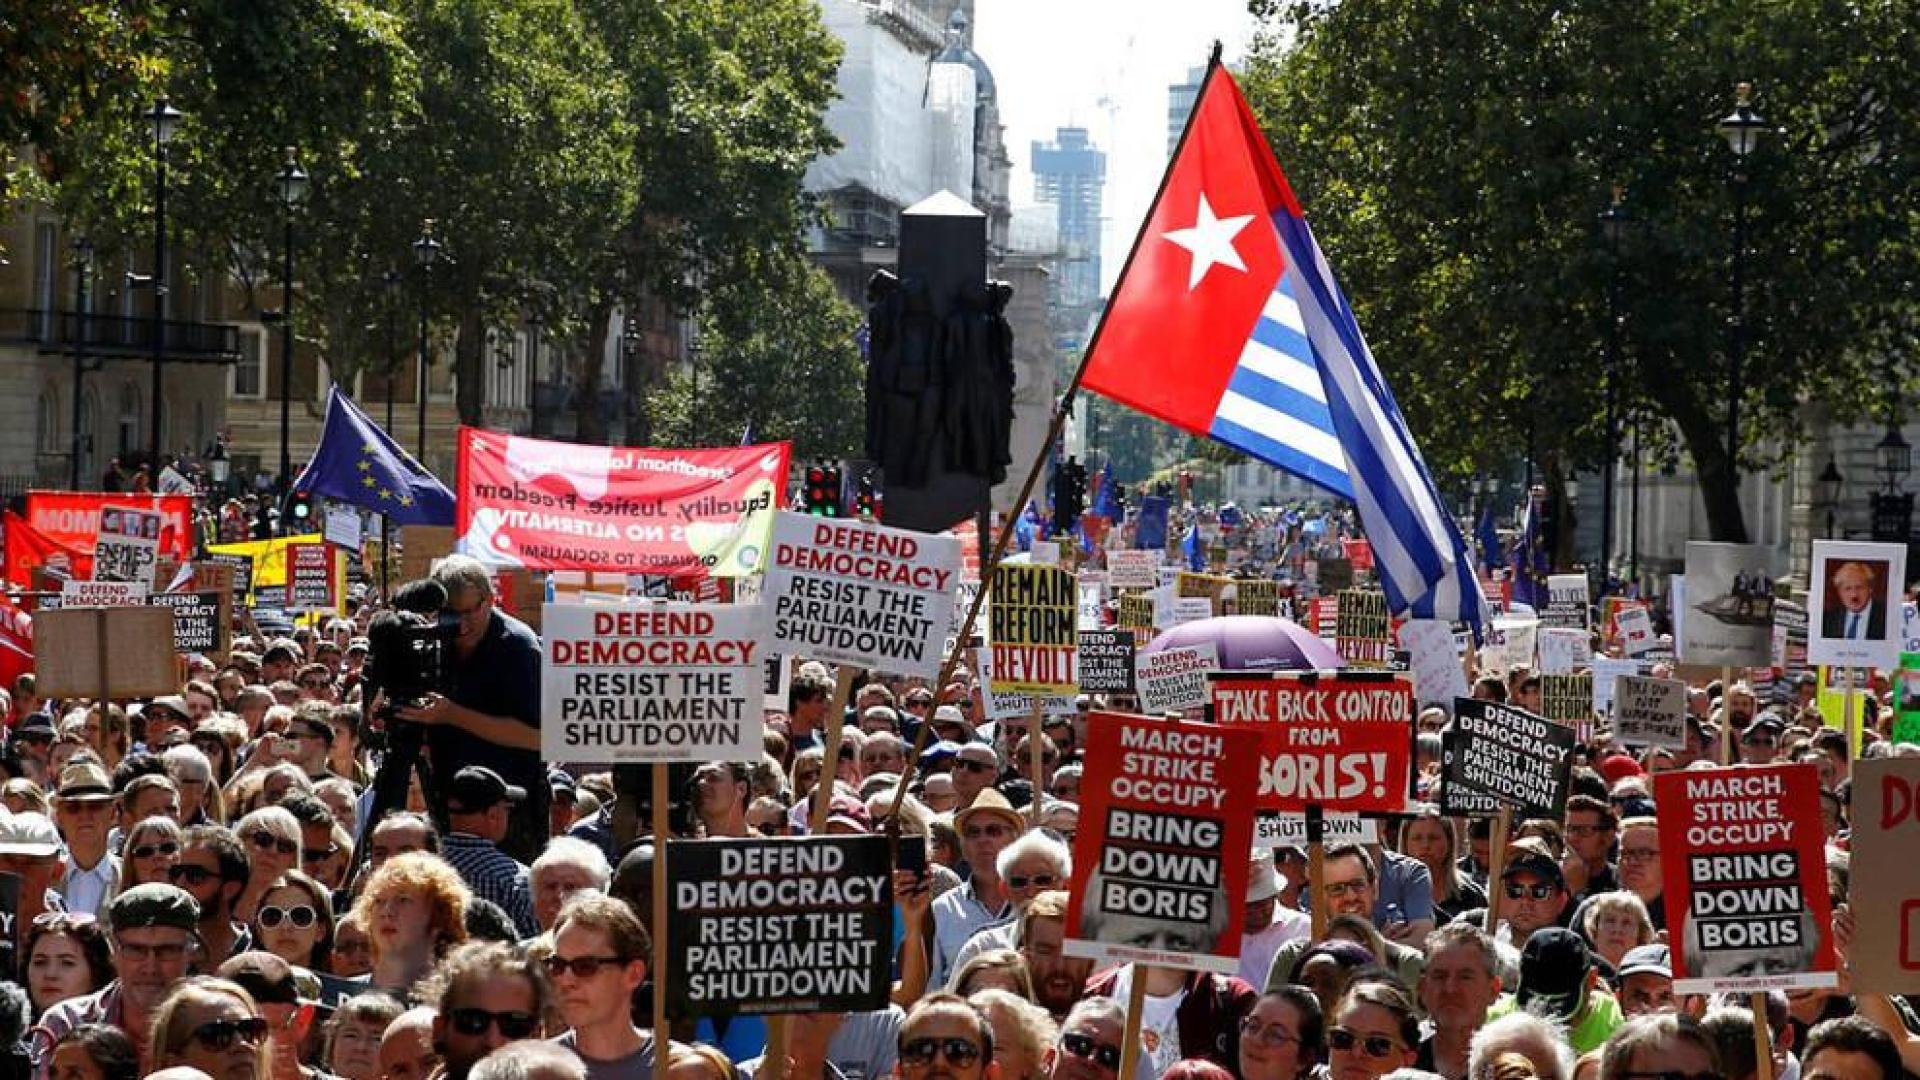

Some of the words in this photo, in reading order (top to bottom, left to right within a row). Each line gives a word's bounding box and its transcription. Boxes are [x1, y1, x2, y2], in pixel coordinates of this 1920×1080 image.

[815, 523, 918, 559] DEFEND
[776, 544, 952, 591] DEMOCRACY
[790, 576, 870, 605] RESIST
[877, 589, 926, 616] THE
[992, 568, 1075, 606] REMAIN
[593, 612, 715, 635] DEFEND
[776, 596, 934, 640] PARLIAMENT
[992, 607, 1075, 645] REFORM
[552, 640, 757, 664] DEMOCRACY
[775, 619, 925, 662] SHUTDOWN
[992, 645, 1077, 685] REVOLT
[575, 673, 671, 695] RESIST
[678, 673, 732, 695] THE
[1543, 675, 1593, 697] REMAIN
[561, 698, 746, 721] PARLIAMENT
[1216, 690, 1269, 722] TAKE
[1277, 690, 1330, 722] BACK
[1336, 689, 1413, 722] CONTROL
[1485, 705, 1547, 738] DEFEND
[565, 723, 739, 745] SHUTDOWN
[1289, 728, 1340, 746] FROM
[1460, 716, 1568, 763] DEMOCRACY
[1464, 749, 1560, 795] PARLIAMENT
[1472, 737, 1520, 766] RESIST
[1524, 755, 1554, 779] THE
[1111, 777, 1226, 809] OCCUPY
[1464, 766, 1554, 809] SHUTDOWN
[1109, 810, 1221, 848] BRING
[1687, 822, 1793, 846] OCCUPY
[721, 845, 844, 876] DEFEND
[1103, 846, 1217, 885] DOWN
[1692, 853, 1795, 882] BRING
[676, 876, 886, 910] DEMOCRACY
[1105, 883, 1209, 920] BORIS
[1694, 886, 1799, 915] DOWN
[700, 914, 798, 944] RESIST
[805, 913, 864, 939] THE
[1702, 920, 1799, 947] BORIS
[686, 940, 878, 972] PARLIAMENT
[688, 968, 871, 1001] SHUTDOWN
